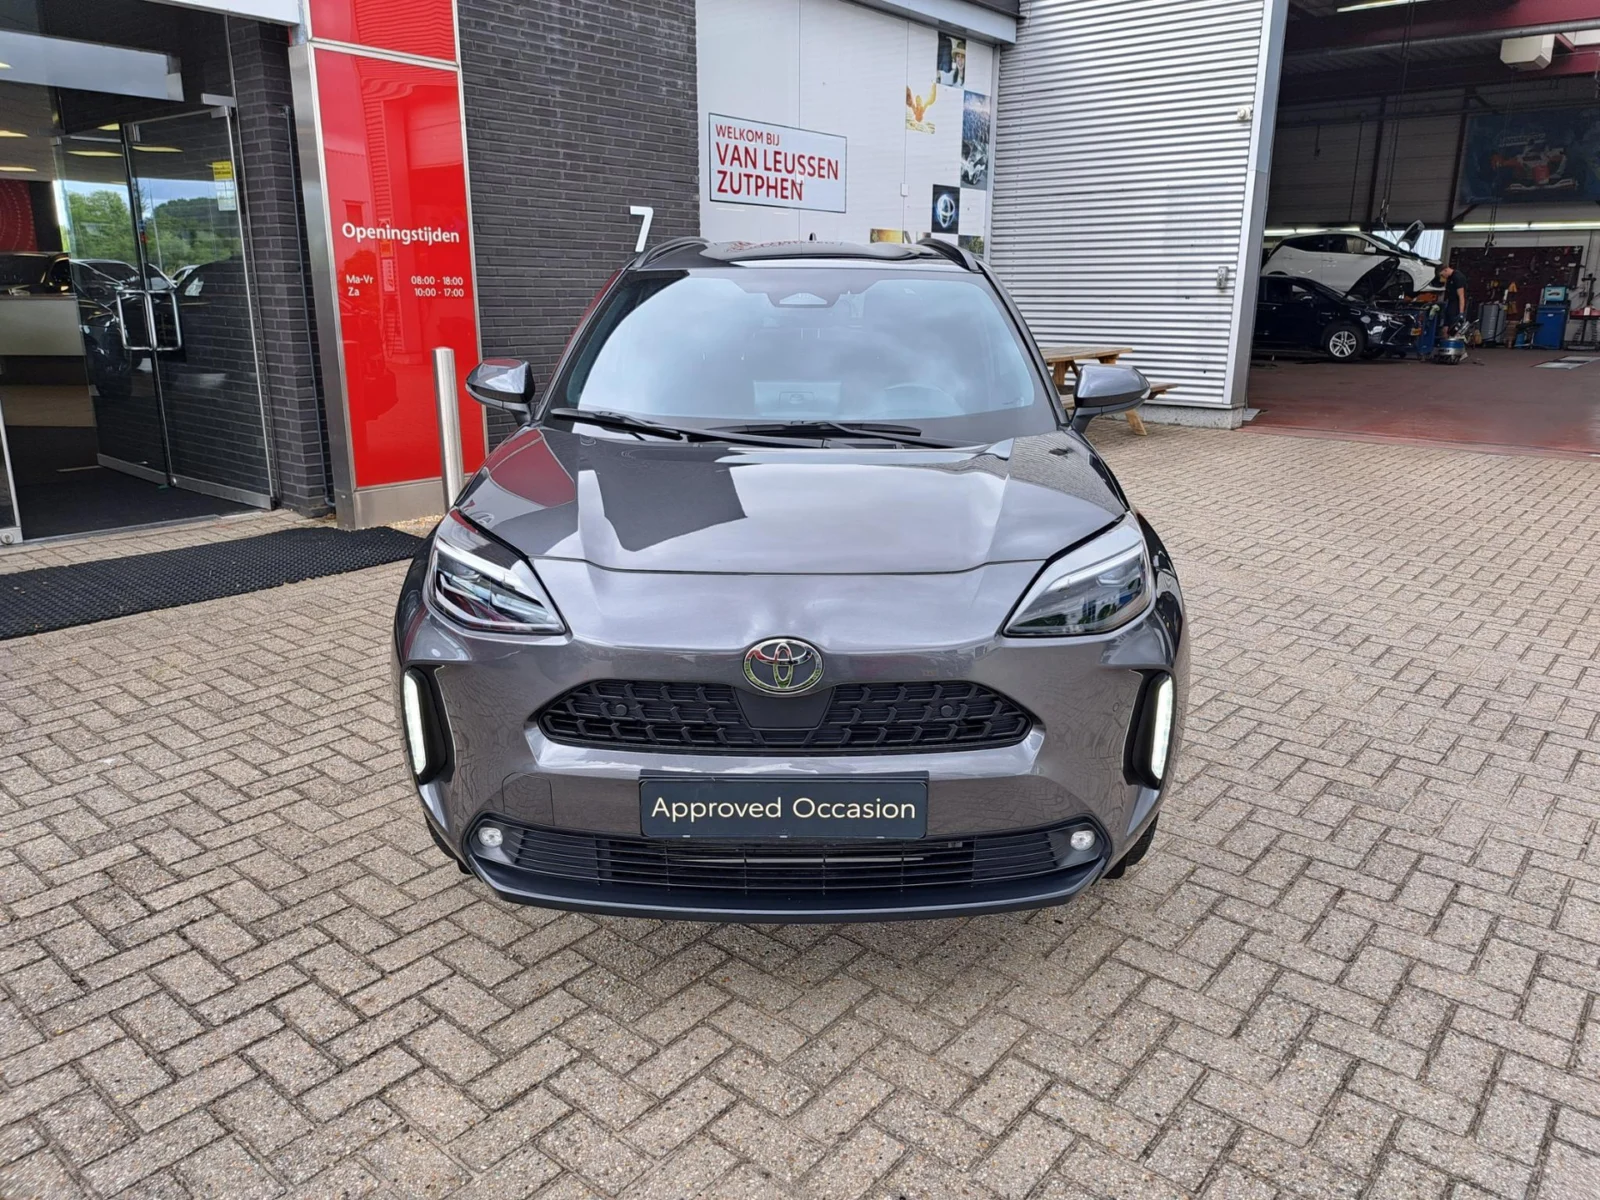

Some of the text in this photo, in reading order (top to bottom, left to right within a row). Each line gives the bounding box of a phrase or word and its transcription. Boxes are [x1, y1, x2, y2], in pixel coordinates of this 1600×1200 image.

[715, 123, 780, 147] WELKOM BIJ
[716, 142, 839, 180] VAN LEUSSEN
[717, 170, 803, 201] ZUTPHEN
[342, 222, 460, 246] Openingstijden
[630, 205, 654, 253] 7
[346, 274, 374, 285] Ma-Vr
[411, 275, 436, 285] 08:00
[442, 276, 464, 286] 18:00
[348, 286, 360, 297] Za
[414, 287, 437, 297] 10:00
[443, 287, 465, 297] 17:00
[651, 796, 916, 823] Approved Occasion
